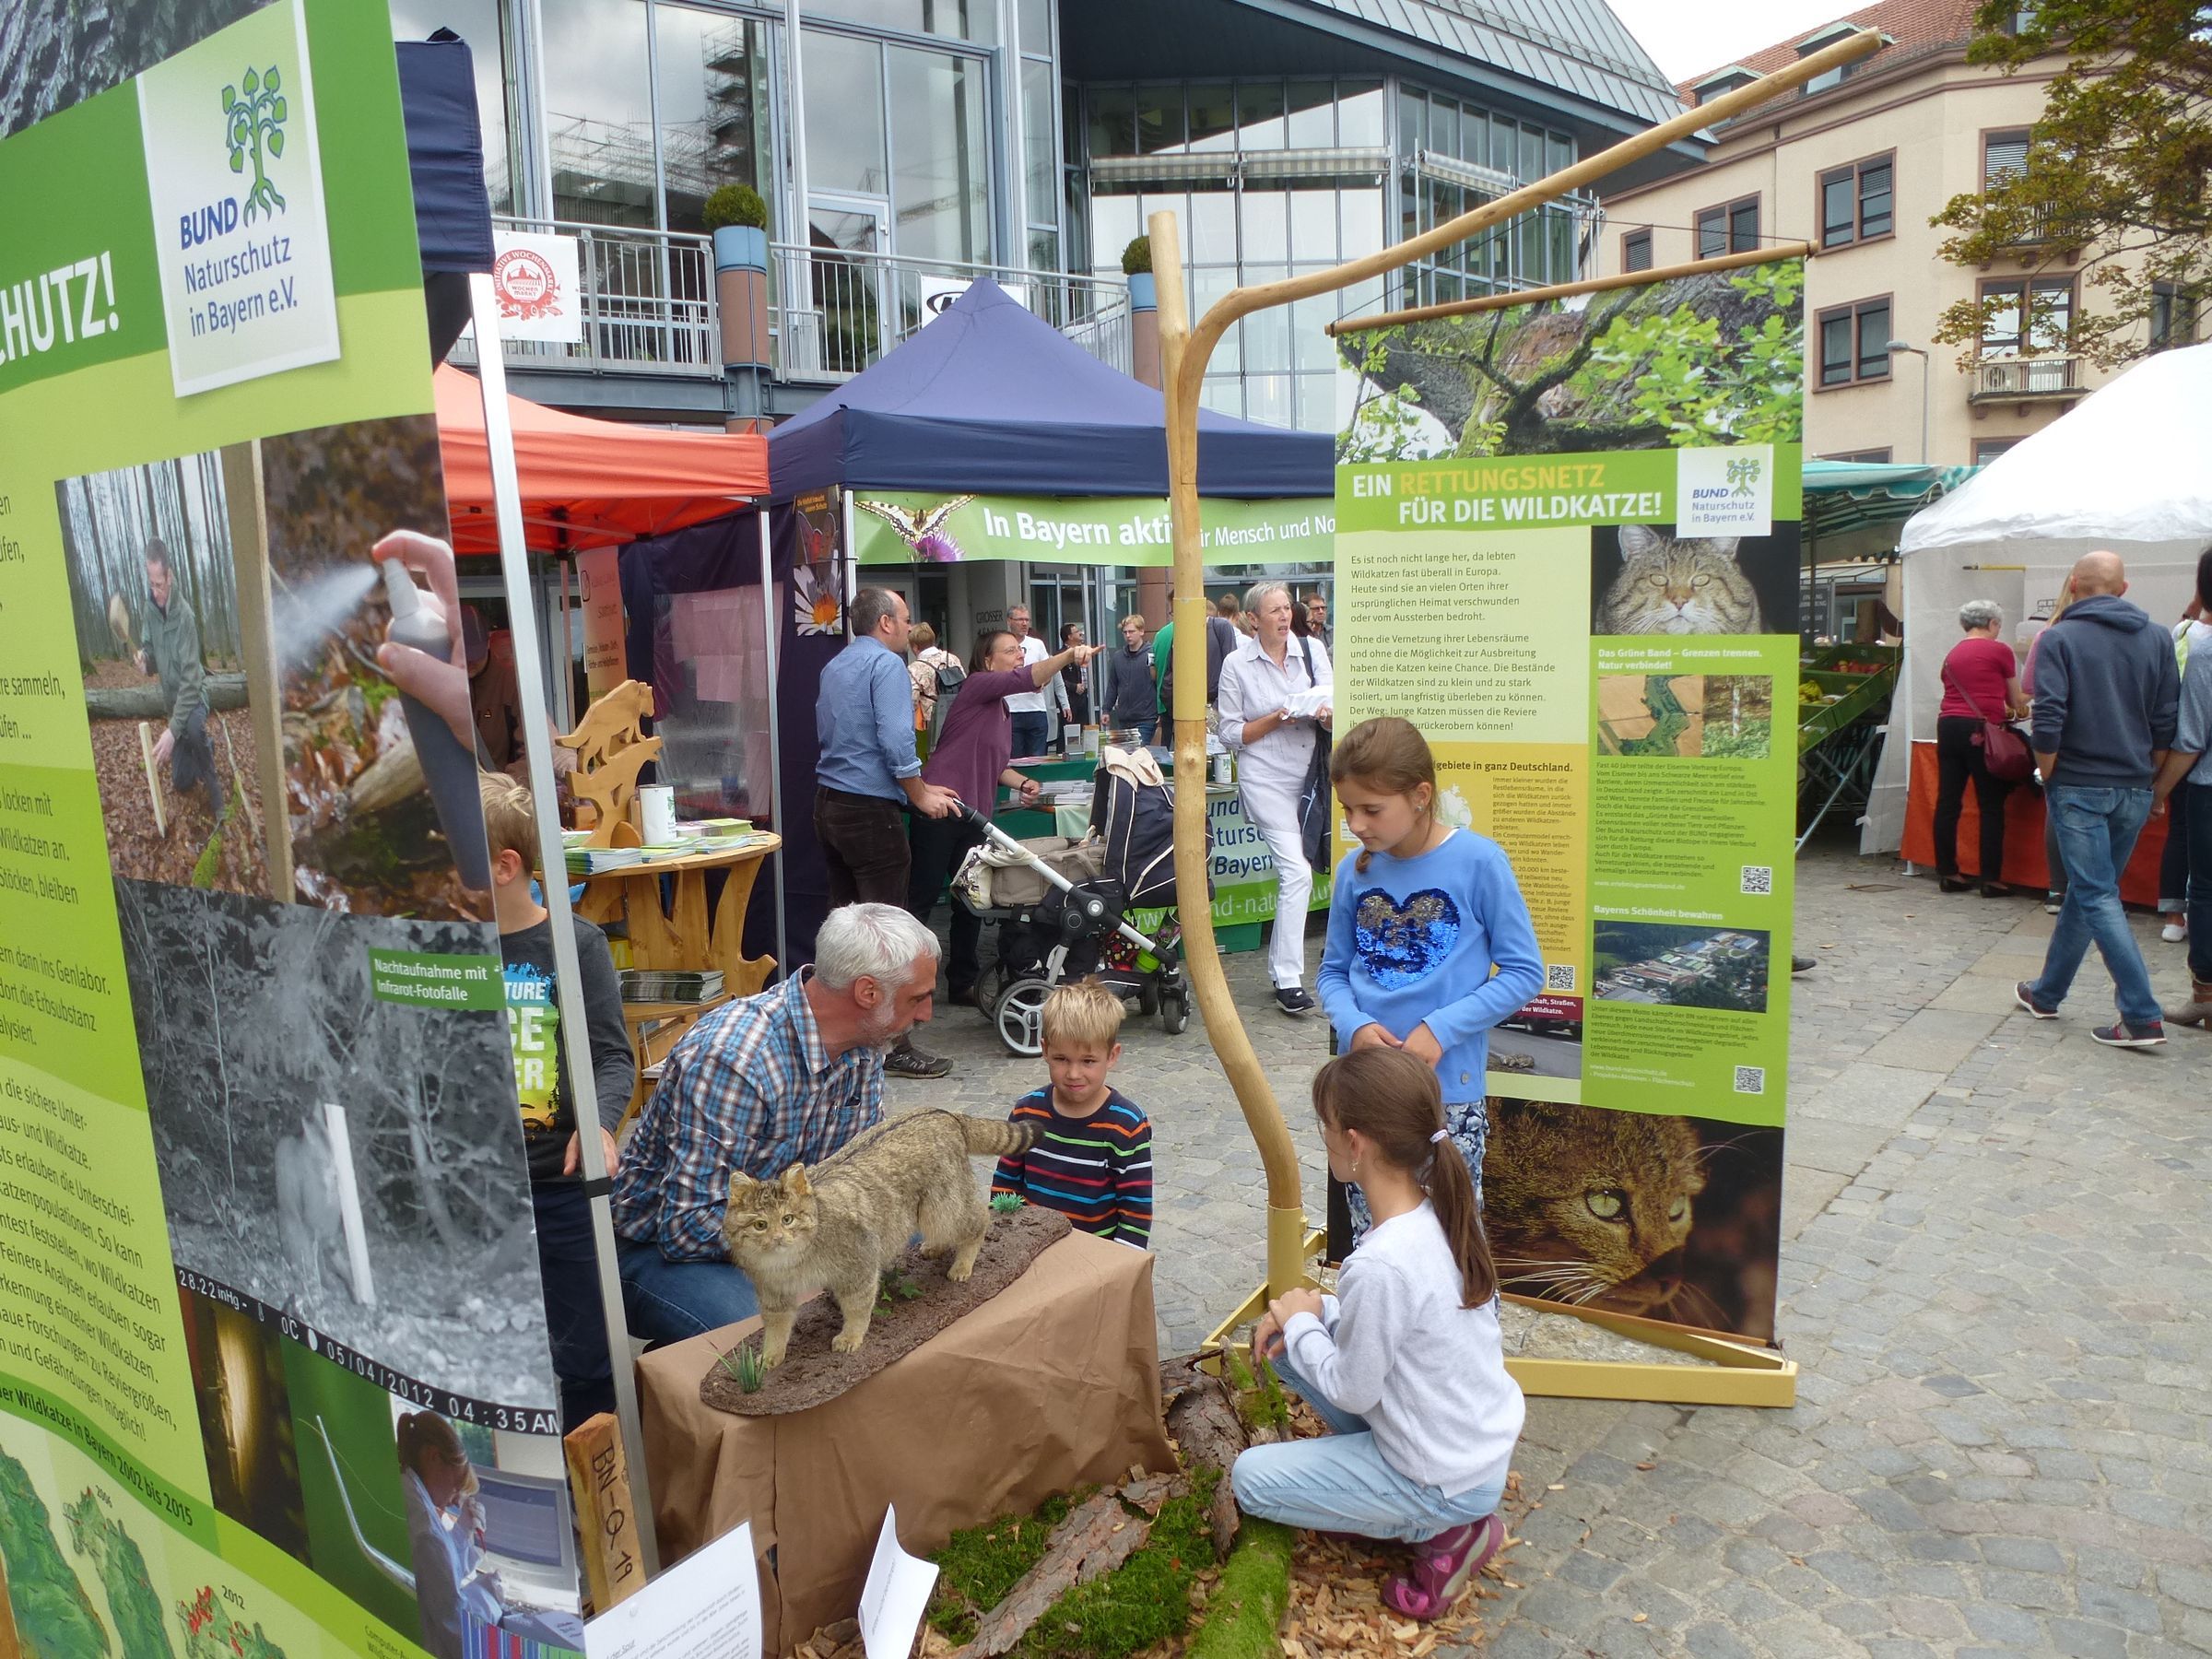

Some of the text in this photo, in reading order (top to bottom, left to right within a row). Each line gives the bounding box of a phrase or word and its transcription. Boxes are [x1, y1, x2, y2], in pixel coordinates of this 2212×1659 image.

[179, 196, 239, 251] BUND
[184, 234, 291, 295] Naturschutz
[0, 250, 120, 367] HUTZ!
[190, 276, 299, 337] in Bayern e.V.
[1353, 464, 1606, 498] EIN RETTUNGSNETZ
[1692, 488, 1729, 500] BUND
[1399, 492, 1662, 524] FÜR DIE WILDKATZE!
[1692, 500, 1755, 512] Naturschutz
[1692, 512, 1755, 524] in Bayern e.V.
[982, 508, 1011, 537] In
[1016, 512, 1111, 549] Bayern
[1119, 515, 1172, 545] akti
[1215, 522, 1275, 547] Mensch
[1280, 519, 1311, 538] und
[1377, 551, 1515, 563] noch nicht lange her, lebten
[1351, 568, 1500, 579] Wildkatzen fast überall Europa.
[1380, 584, 1398, 593] sind
[1430, 582, 1456, 591] vielen
[1459, 582, 1484, 591] Orten
[1351, 597, 1519, 609] ursprünglichen Heimat verschwunden
[1351, 612, 1485, 622] oder Aussterben bedroht.
[1350, 634, 1529, 644] Ohne Vernetzung ihrer Lebensräume
[1599, 649, 1615, 657] Das
[1618, 649, 1645, 657] Grüne
[1648, 649, 1671, 657] Band
[1410, 649, 1462, 659] Möglichkeit
[1480, 649, 1535, 658] Ausbreitung
[1429, 664, 1452, 672] keine
[1455, 664, 1490, 672] Chance.
[1512, 664, 1555, 672] Bestände
[1598, 661, 1672, 669] Natur verbindet!
[13, 670, 65, 700] sammeln,
[1350, 692, 1382, 700] isoliert,
[1401, 692, 1444, 702] langfristig
[1509, 693, 1546, 701] können.
[1452, 678, 1472, 687] klein
[1509, 678, 1531, 687] stark
[1367, 707, 1390, 718] Weg:
[1388, 708, 1414, 718] Junge
[1418, 707, 1446, 715] Katzen
[1413, 721, 1512, 732] urückerobern können!
[1474, 761, 1481, 770] in
[1511, 762, 1572, 771] Deutschland.
[2, 787, 53, 817] locken mit
[0, 828, 70, 861] Wildkatzen an.
[40, 876, 78, 905] bleiben
[1594, 905, 1723, 920] Bayerns Schönheit bewahren
[17, 951, 39, 973] dann
[39, 953, 55, 979] ins
[56, 959, 111, 995] Genlabor.
[374, 959, 488, 982] Nachtaufnahme mit
[376, 979, 468, 1002] Infrarot-Fotofalle
[20, 983, 35, 1008] die
[35, 989, 97, 1031] Erbsubstanz
[6, 1077, 88, 1131] die sichere Unter-
[24, 1122, 42, 1144] und
[44, 1131, 91, 1171] Wildkatze.
[16, 1149, 59, 1185] erlauben
[61, 1167, 75, 1191] die
[76, 1172, 135, 1227] Unterschei-
[98, 1229, 112, 1253] So
[113, 1235, 144, 1269] kann
[30, 1220, 84, 1270] feststellen,
[84, 1256, 99, 1278] wo
[100, 1261, 161, 1314] Wildkatzen
[0, 1241, 166, 1353] Feinere Analysen erlauben sogar
[55, 1298, 159, 1383] einzelner Wildkatzen.
[25, 1312, 177, 1431] Forschungen zu Reviergrößen,
[326, 1341, 434, 1409] 05/04/2012
[8, 1341, 146, 1441] und Gefährdungen möglich!
[17, 1386, 194, 1526] Wildkatze in Bayern 2002 bis 2015
[221, 1584, 245, 1610] 2012
